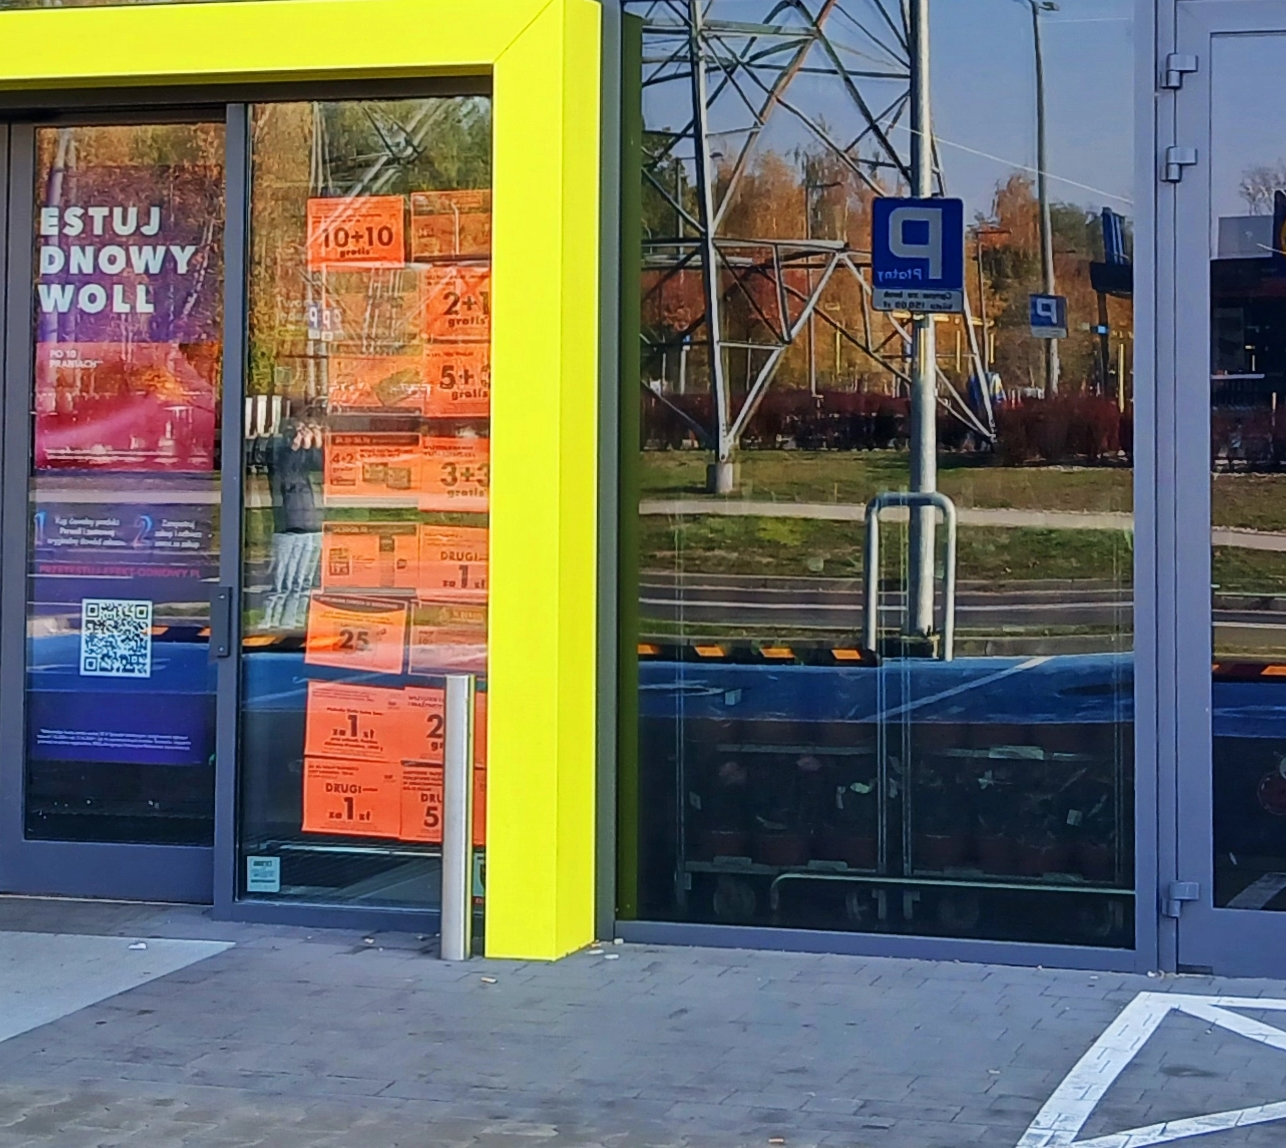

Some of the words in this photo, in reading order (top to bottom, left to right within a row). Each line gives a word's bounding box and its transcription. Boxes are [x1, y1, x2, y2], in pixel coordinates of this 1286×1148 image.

[323, 225, 394, 249] 10+10
[347, 714, 358, 738] 1
[325, 782, 362, 794] DRUGI
[343, 796, 354, 821] 1
[423, 805, 440, 828] 5
